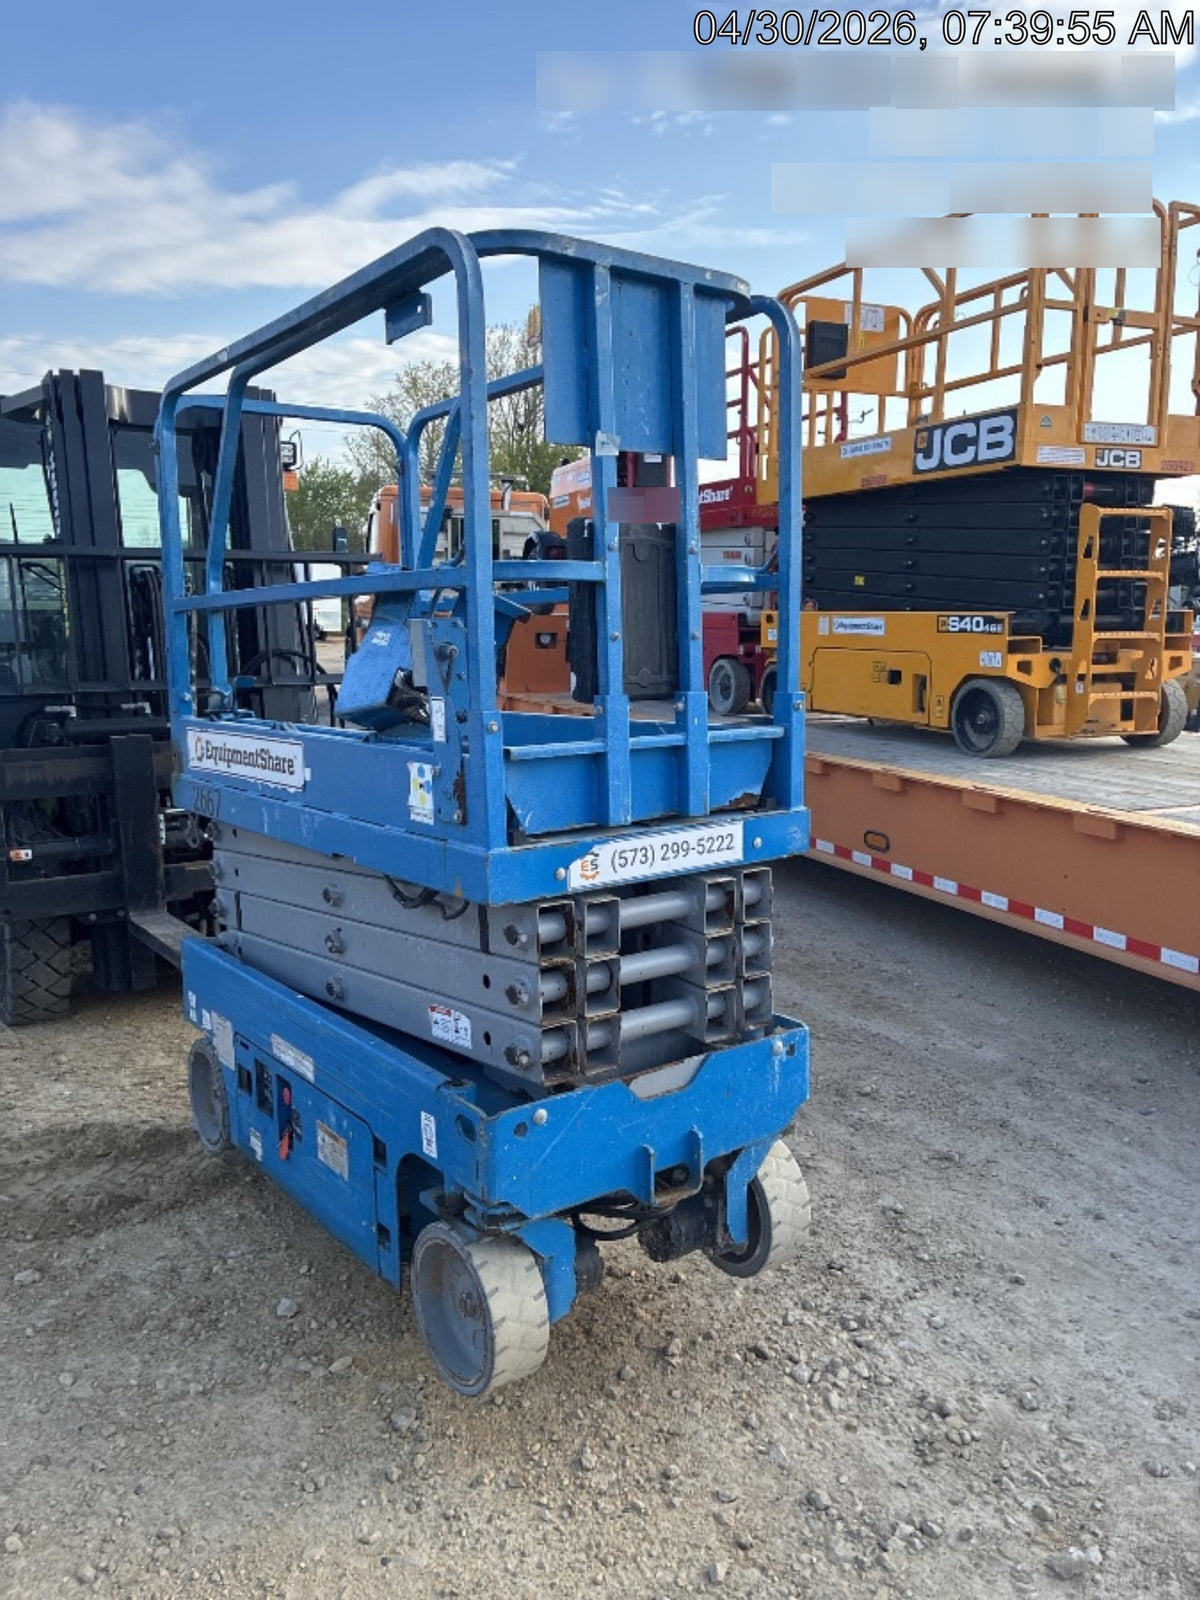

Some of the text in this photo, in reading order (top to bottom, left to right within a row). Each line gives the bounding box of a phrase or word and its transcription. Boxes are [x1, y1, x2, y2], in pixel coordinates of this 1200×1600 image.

[914, 414, 1016, 471] JCB
[1095, 449, 1141, 468] JCB
[205, 739, 296, 776] EquipmentShare
[610, 833, 735, 873] (573) 299-5222
